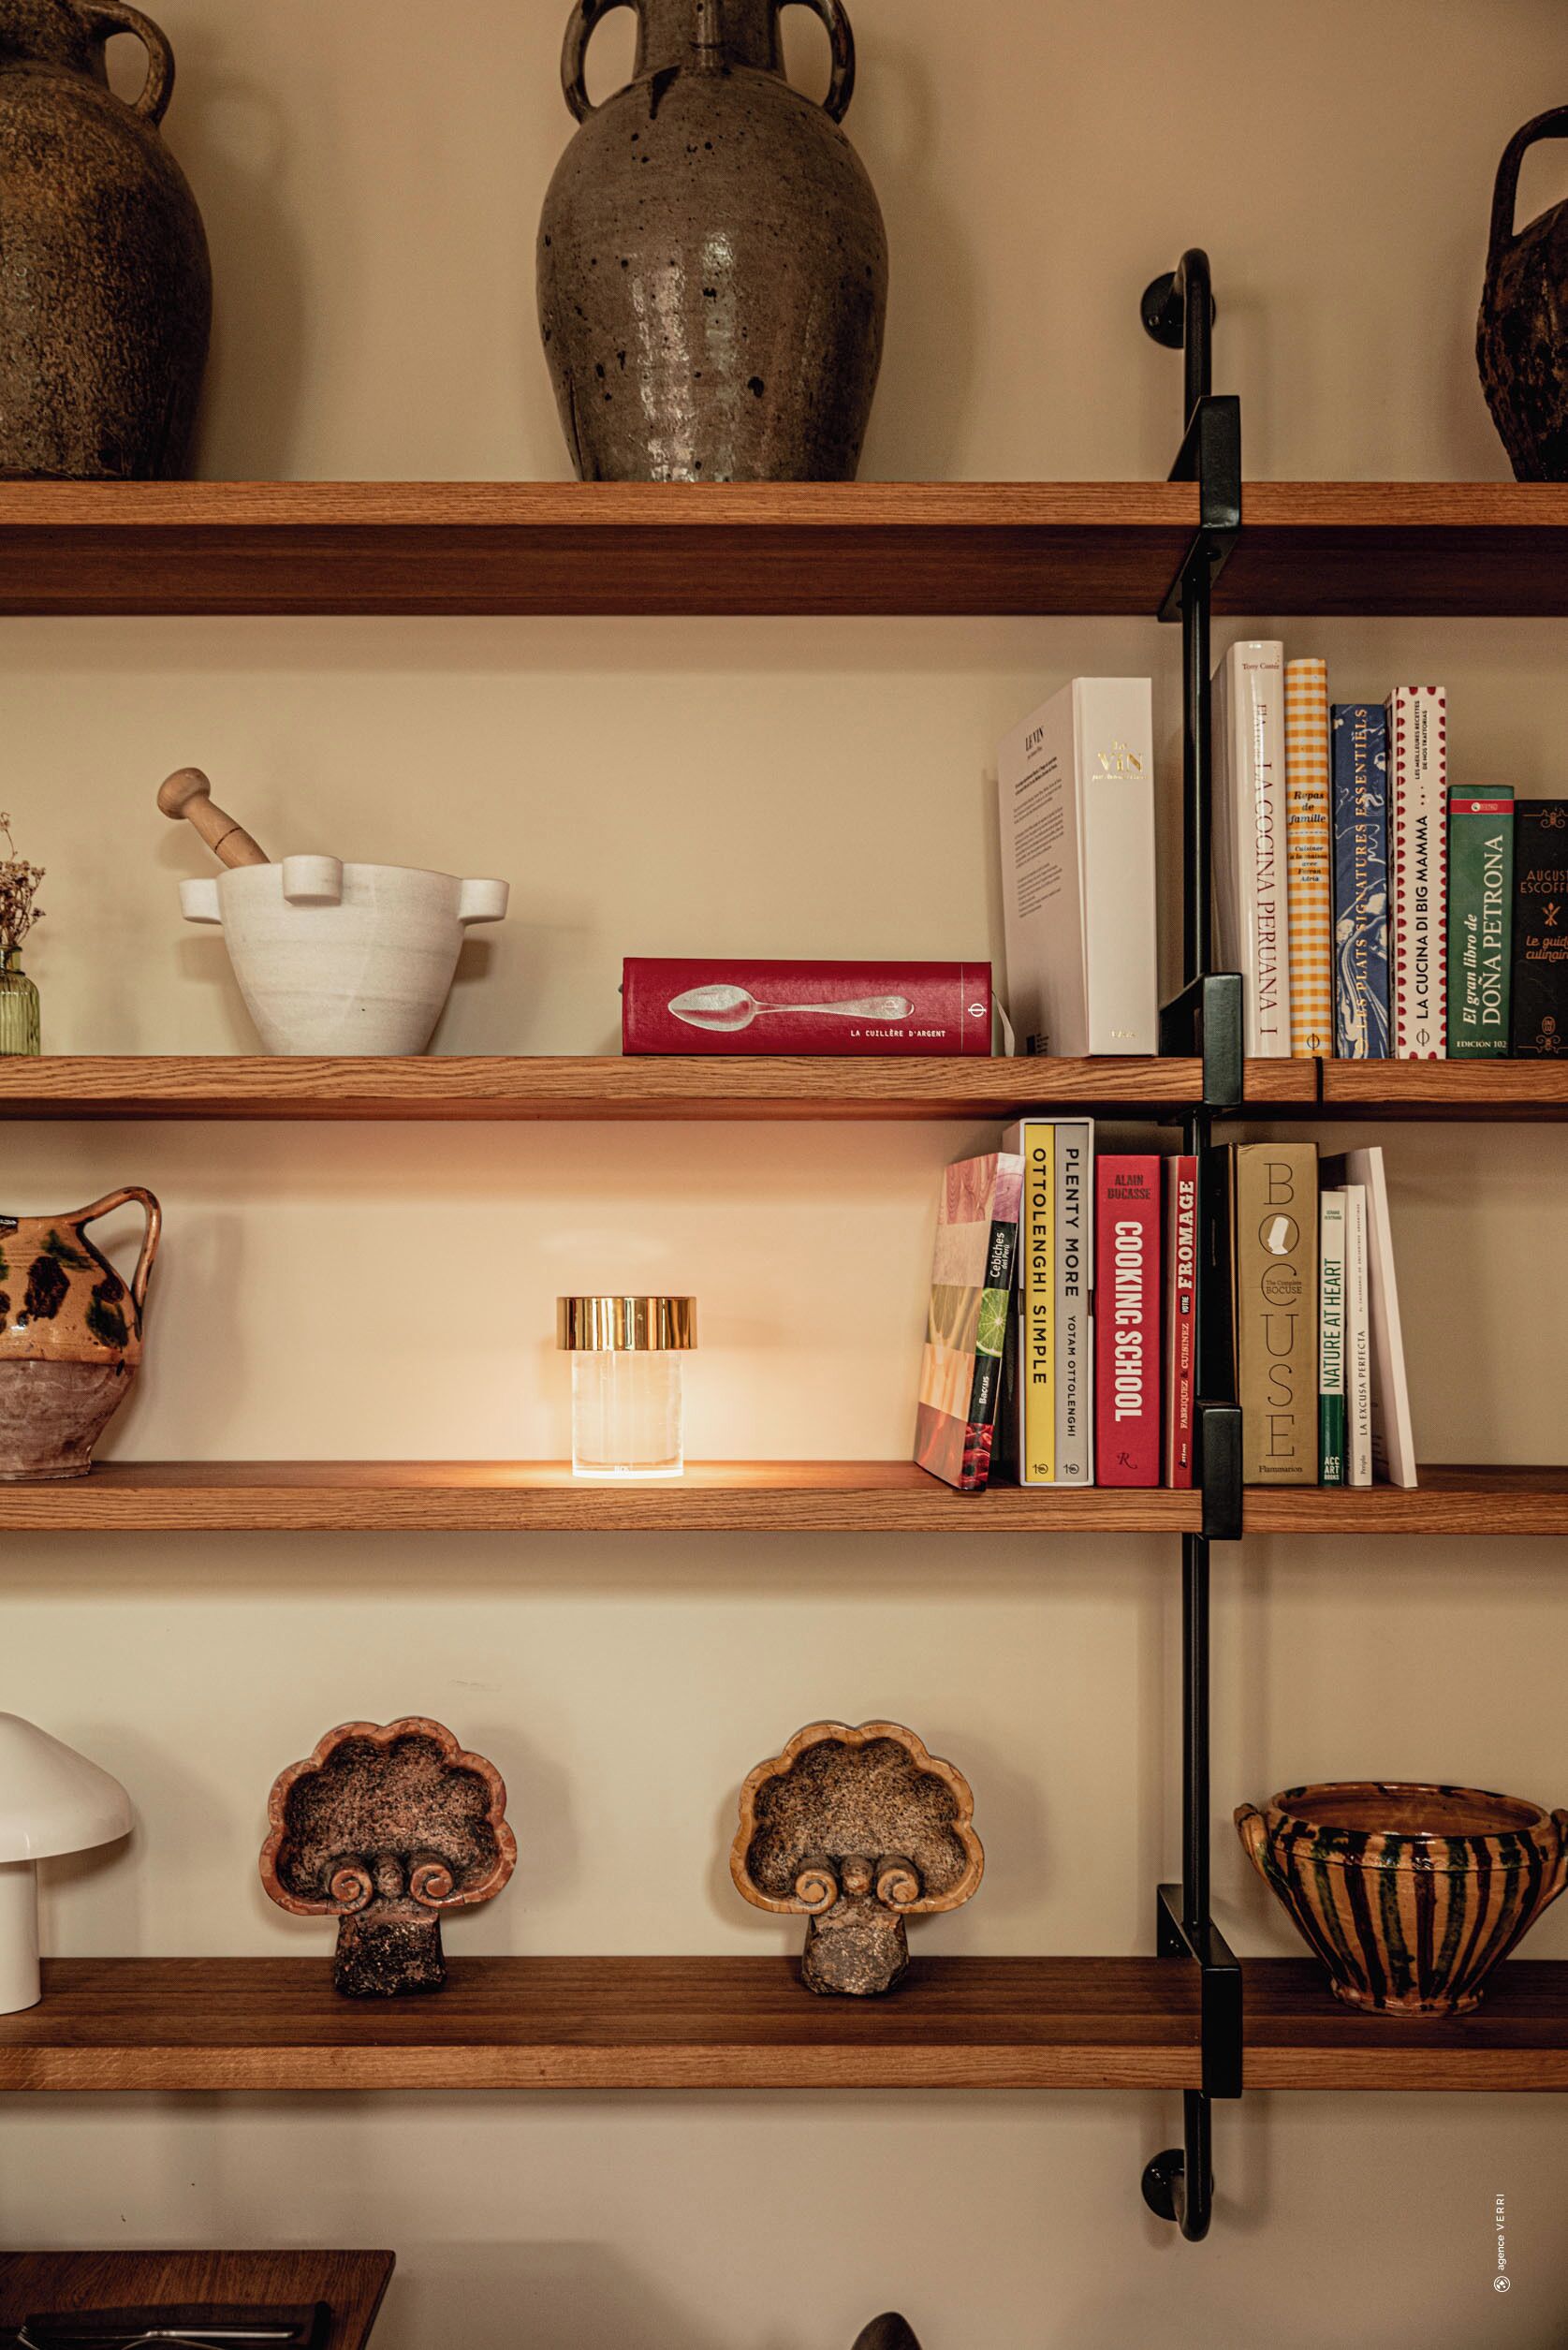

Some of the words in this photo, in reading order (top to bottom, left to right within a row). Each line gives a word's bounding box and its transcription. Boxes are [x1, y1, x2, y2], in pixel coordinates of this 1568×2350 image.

[1355, 708, 1368, 816] ESSENTIELS
[1422, 762, 1428, 771] DE
[1294, 791, 1325, 800] Repas
[1302, 802, 1314, 811] de
[1289, 814, 1326, 826] famille
[1255, 800, 1275, 893] COCINA
[1414, 815, 1429, 883] MAMMA
[1355, 822, 1368, 933] SIGNATURES
[1415, 887, 1429, 912] BIG
[1483, 834, 1503, 949] PETRONA
[1415, 916, 1429, 931] DI
[1463, 914, 1478, 931] de
[1526, 936, 1540, 947] Le
[1257, 900, 1278, 1012] PERUANA
[1356, 938, 1368, 992] PLATS
[1415, 935, 1429, 994] CUCINA
[1463, 934, 1477, 968] libro
[1415, 998, 1429, 1019] LA
[1467, 971, 1479, 1006] gran
[1478, 954, 1502, 1025] DOÑA
[865, 1028, 903, 1037] CUILLÈRE
[1462, 1007, 1477, 1025] El
[1456, 1039, 1491, 1049] EDICIÓN
[1065, 1148, 1079, 1228] PLENTY
[1107, 1188, 1150, 1199] DUCASSE
[1115, 1174, 1144, 1185] ALAIN
[1033, 1148, 1047, 1293] OTTOLENGHI
[1177, 1180, 1195, 1289] FROMAGE
[989, 1231, 1005, 1279] Cebiches
[1065, 1238, 1079, 1297] MORE
[1114, 1221, 1143, 1326] COOKING
[1324, 1257, 1341, 1306] HEART
[1067, 1315, 1077, 1356] YOTAM
[1323, 1310, 1341, 1327] AT
[1033, 1305, 1047, 1384] SIMPLE
[1180, 1322, 1191, 1369] CUISINEZ
[1323, 1330, 1341, 1388] NATURE
[1357, 1330, 1367, 1378] PERFECTA
[1114, 1330, 1143, 1422] SCHOOL
[1067, 1360, 1077, 1437] OTTOLENGHI
[1180, 1379, 1190, 1429] FABRIQUEZ
[1358, 1382, 1368, 1419] EXCUSA
[1359, 1424, 1368, 1436] LA
[1258, 1465, 1303, 1474] Flammarion
[1324, 1456, 1340, 1465] ACC
[1324, 1465, 1340, 1475] ART
